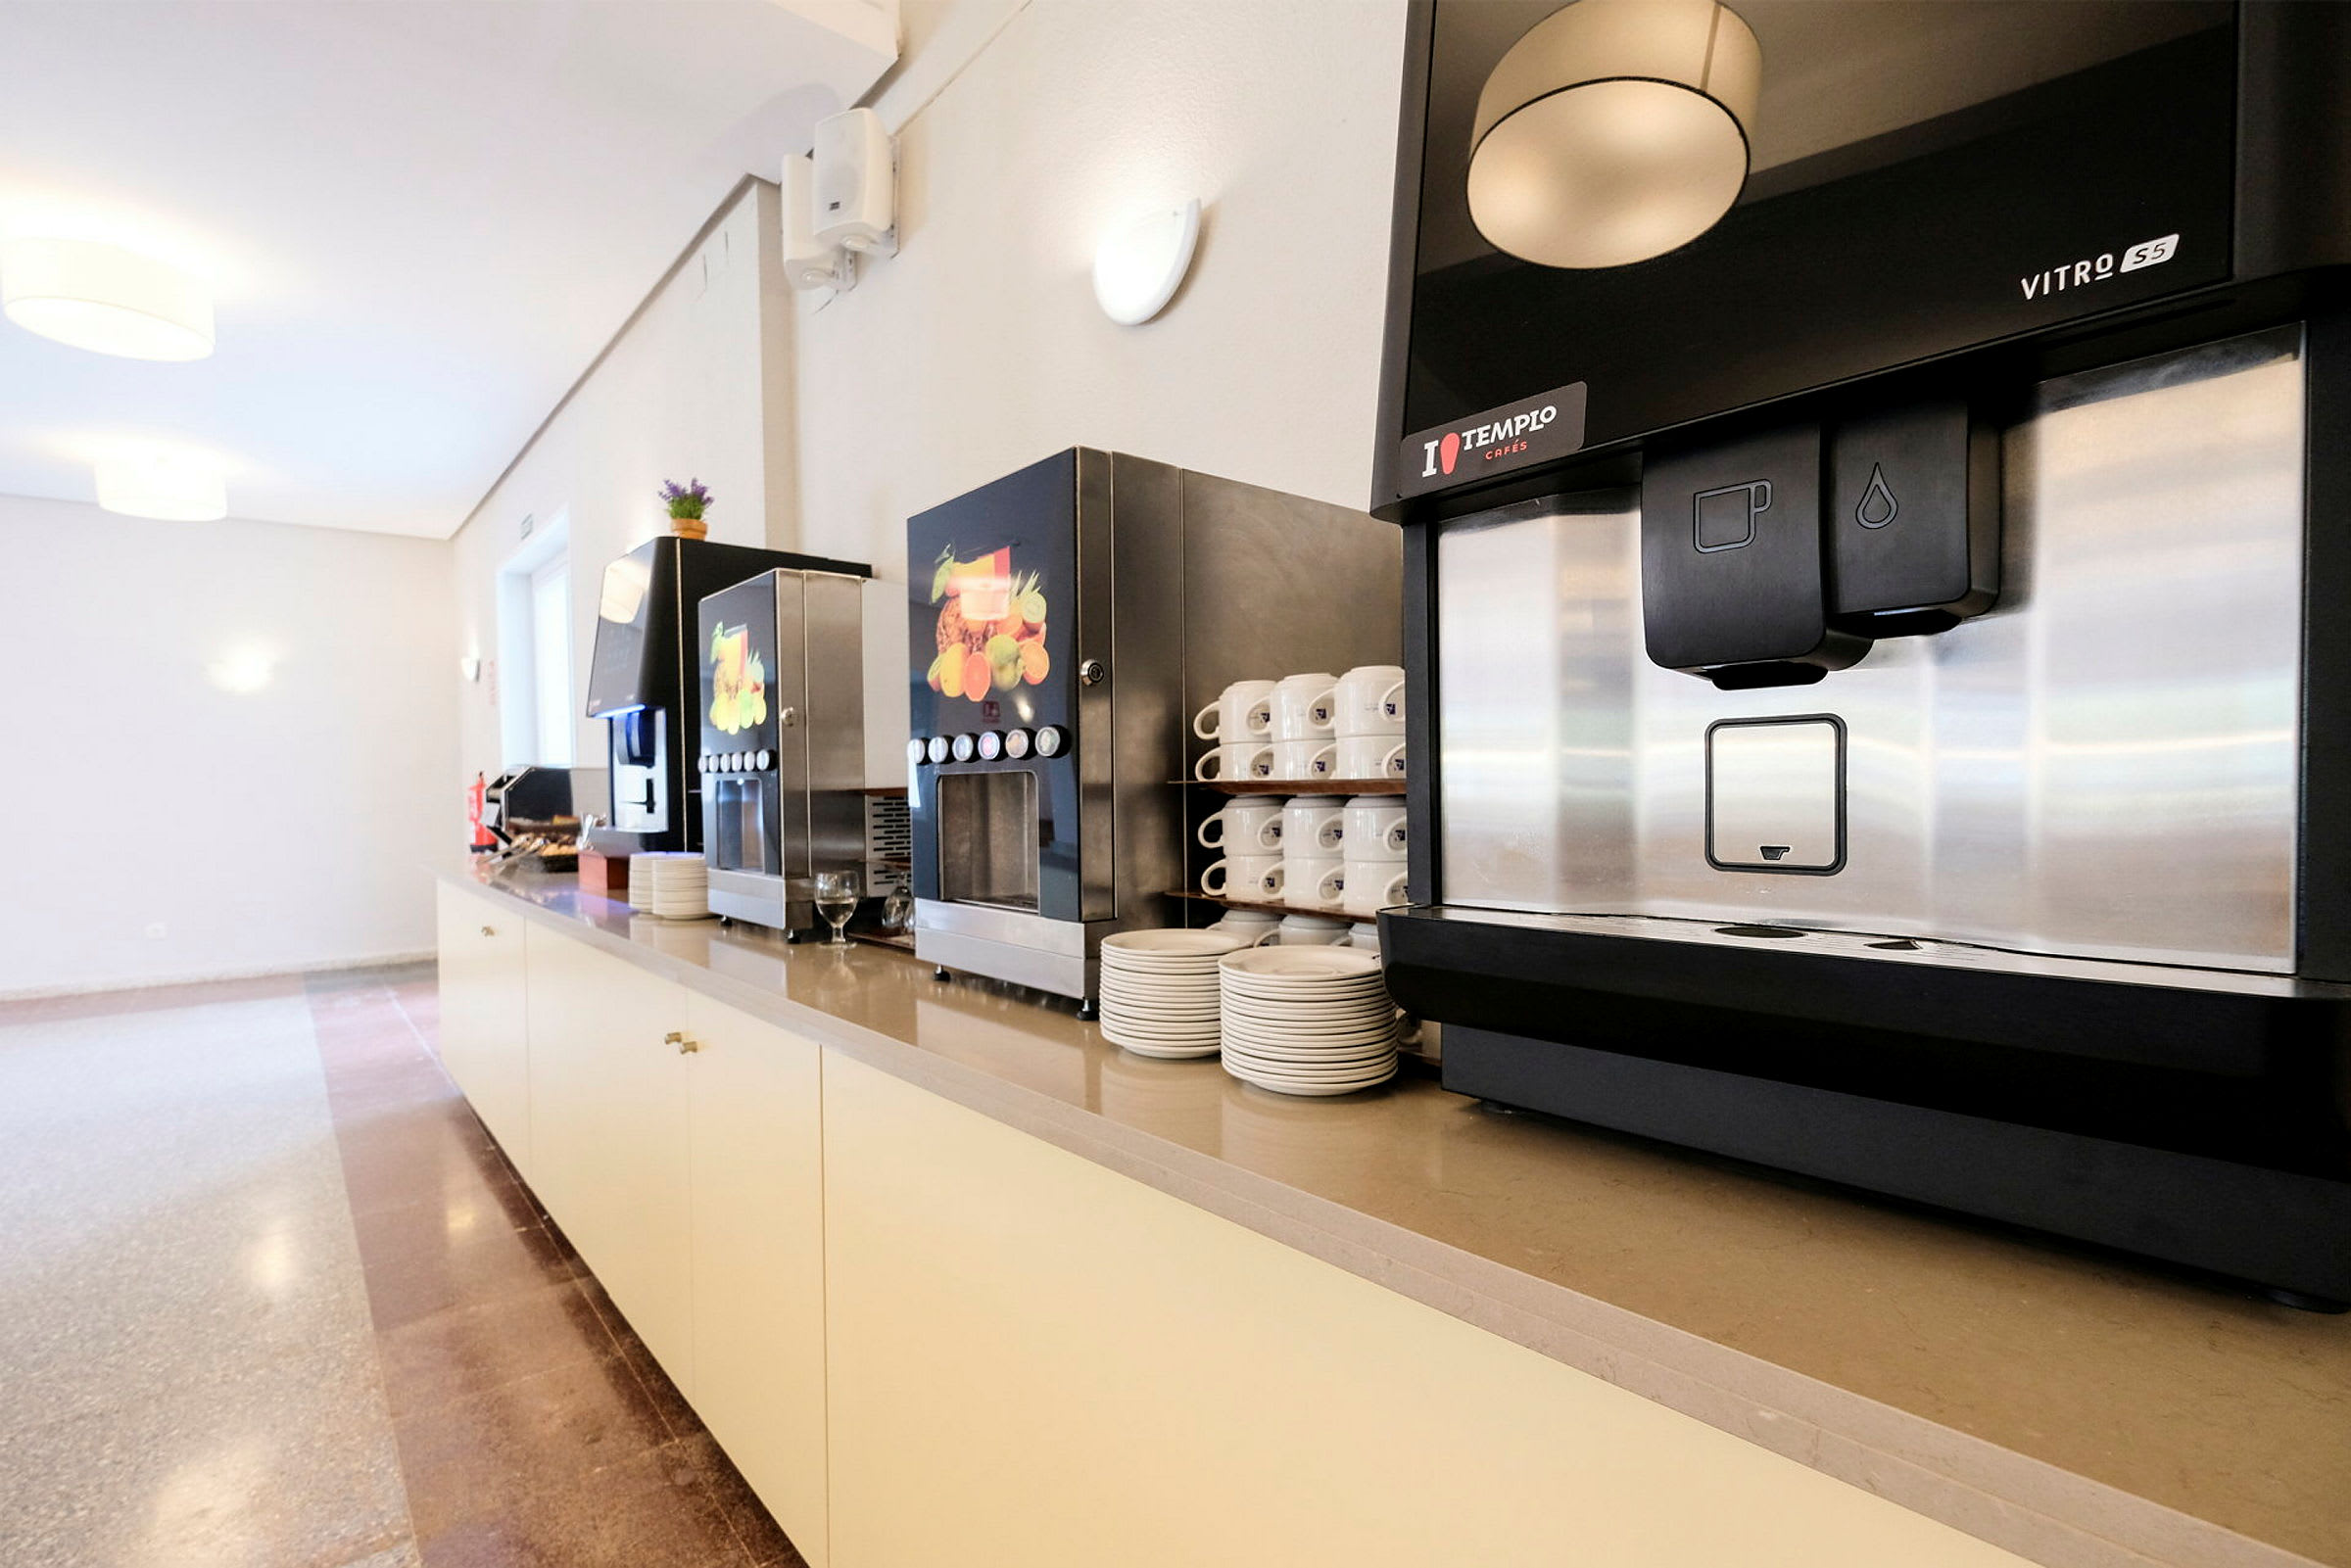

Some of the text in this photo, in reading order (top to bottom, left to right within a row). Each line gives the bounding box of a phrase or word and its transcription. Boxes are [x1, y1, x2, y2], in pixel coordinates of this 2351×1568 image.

[2021, 253, 2114, 301] VITRO
[1461, 404, 1558, 451] TEMPLO
[1485, 439, 1528, 460] CAFÉS
